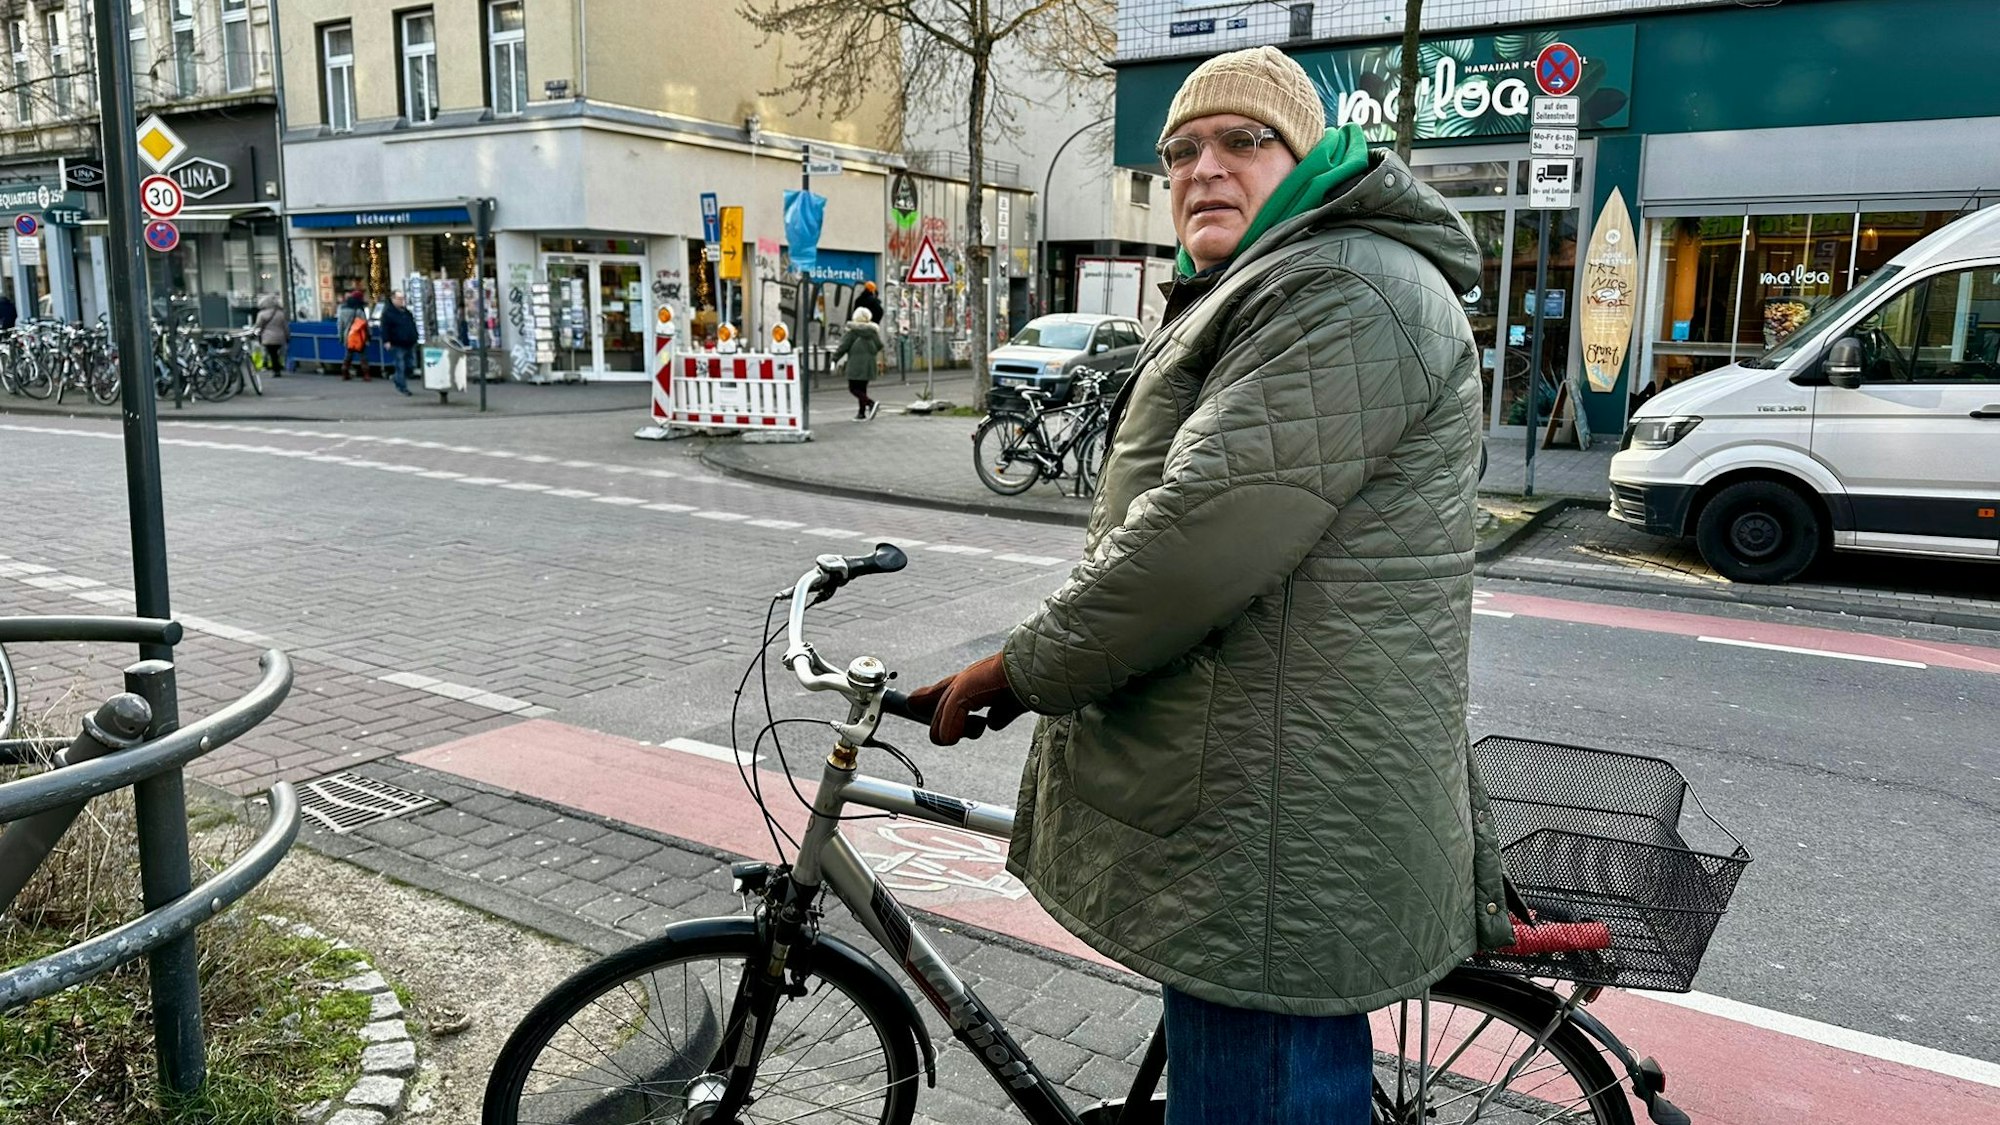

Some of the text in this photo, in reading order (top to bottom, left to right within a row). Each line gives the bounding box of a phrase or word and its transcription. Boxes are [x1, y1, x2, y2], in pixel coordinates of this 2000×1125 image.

[1465, 61, 1520, 74] HAWAIIAN
[73, 169, 95, 178] LINA
[179, 167, 217, 188] LINA
[149, 187, 174, 207] 30
[52, 210, 82, 224] TEE
[1760, 264, 1830, 284] ma'loa
[911, 955, 1038, 1092] Kalkhoff
